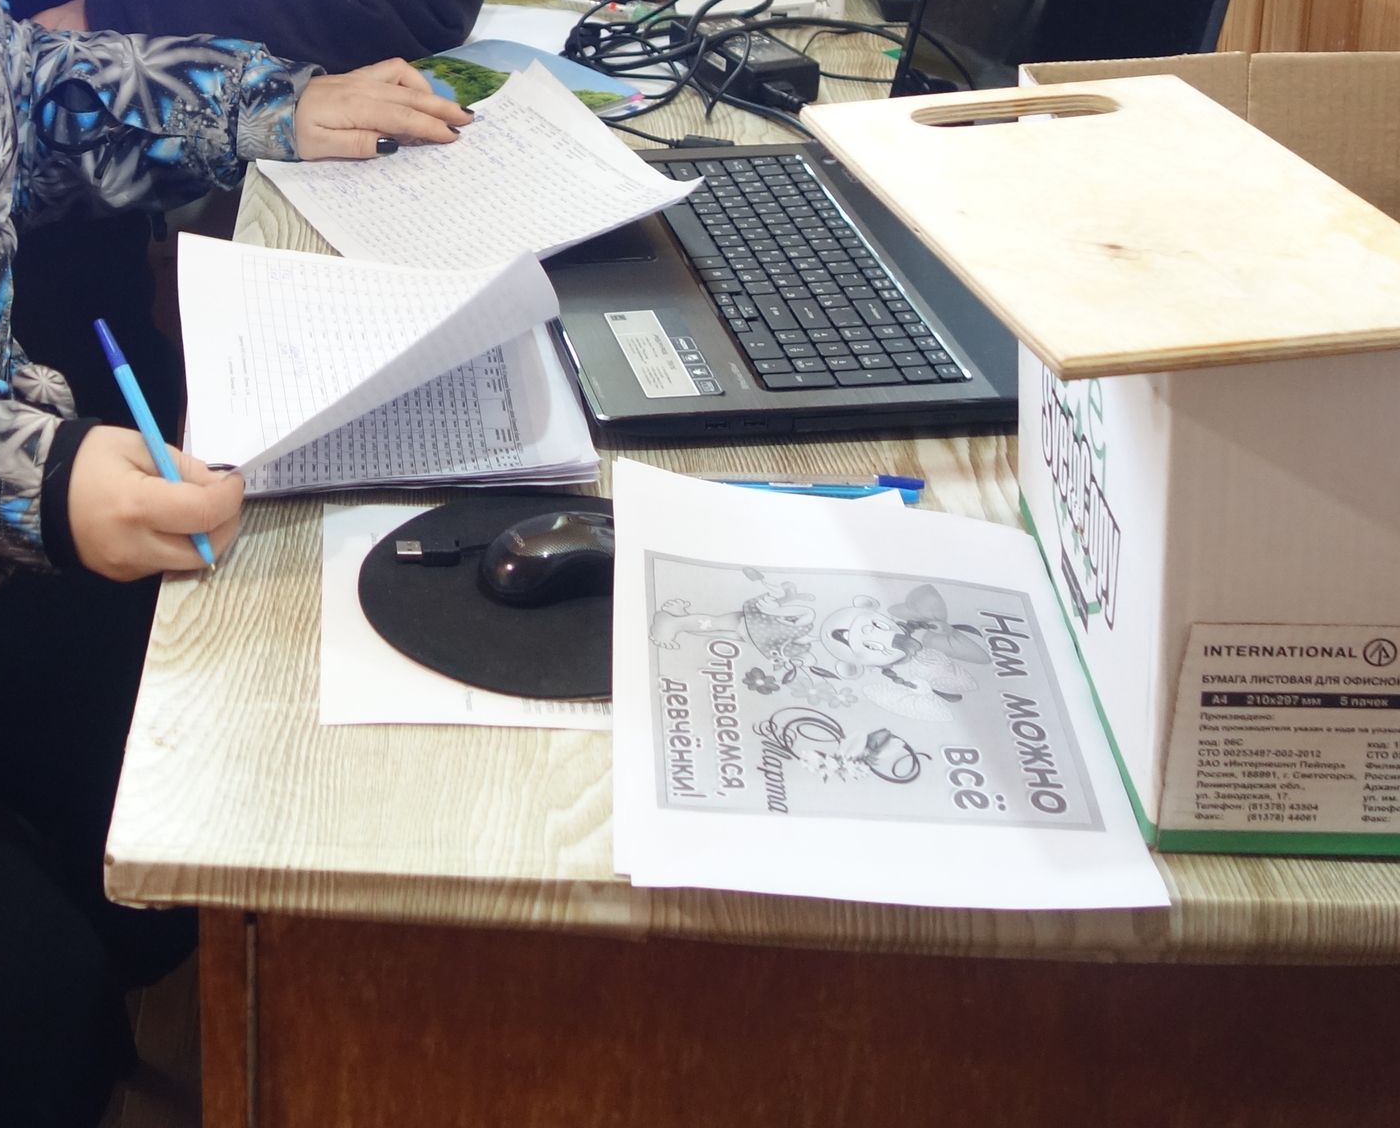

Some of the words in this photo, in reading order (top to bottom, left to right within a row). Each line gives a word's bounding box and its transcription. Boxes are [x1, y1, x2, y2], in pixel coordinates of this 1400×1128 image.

[1041, 362, 1121, 632] SvetoCopy
[979, 611, 1031, 677] Нам
[1203, 645, 1358, 659] INTERNATIONAL
[1202, 675, 1247, 685] БУМАГА
[1250, 675, 1312, 686] ЛИСТОВАЯ
[1315, 676, 1340, 687] ДЛЯ
[1302, 698, 1322, 706] мм
[1340, 697, 1348, 707] 5
[1351, 700, 1389, 708] пачек
[701, 639, 745, 797] Отрываемся,
[1002, 692, 1068, 815] можно
[1198, 749, 1220, 758] СТО
[1367, 751, 1390, 760] СТО
[1197, 760, 1220, 768] ЗАО
